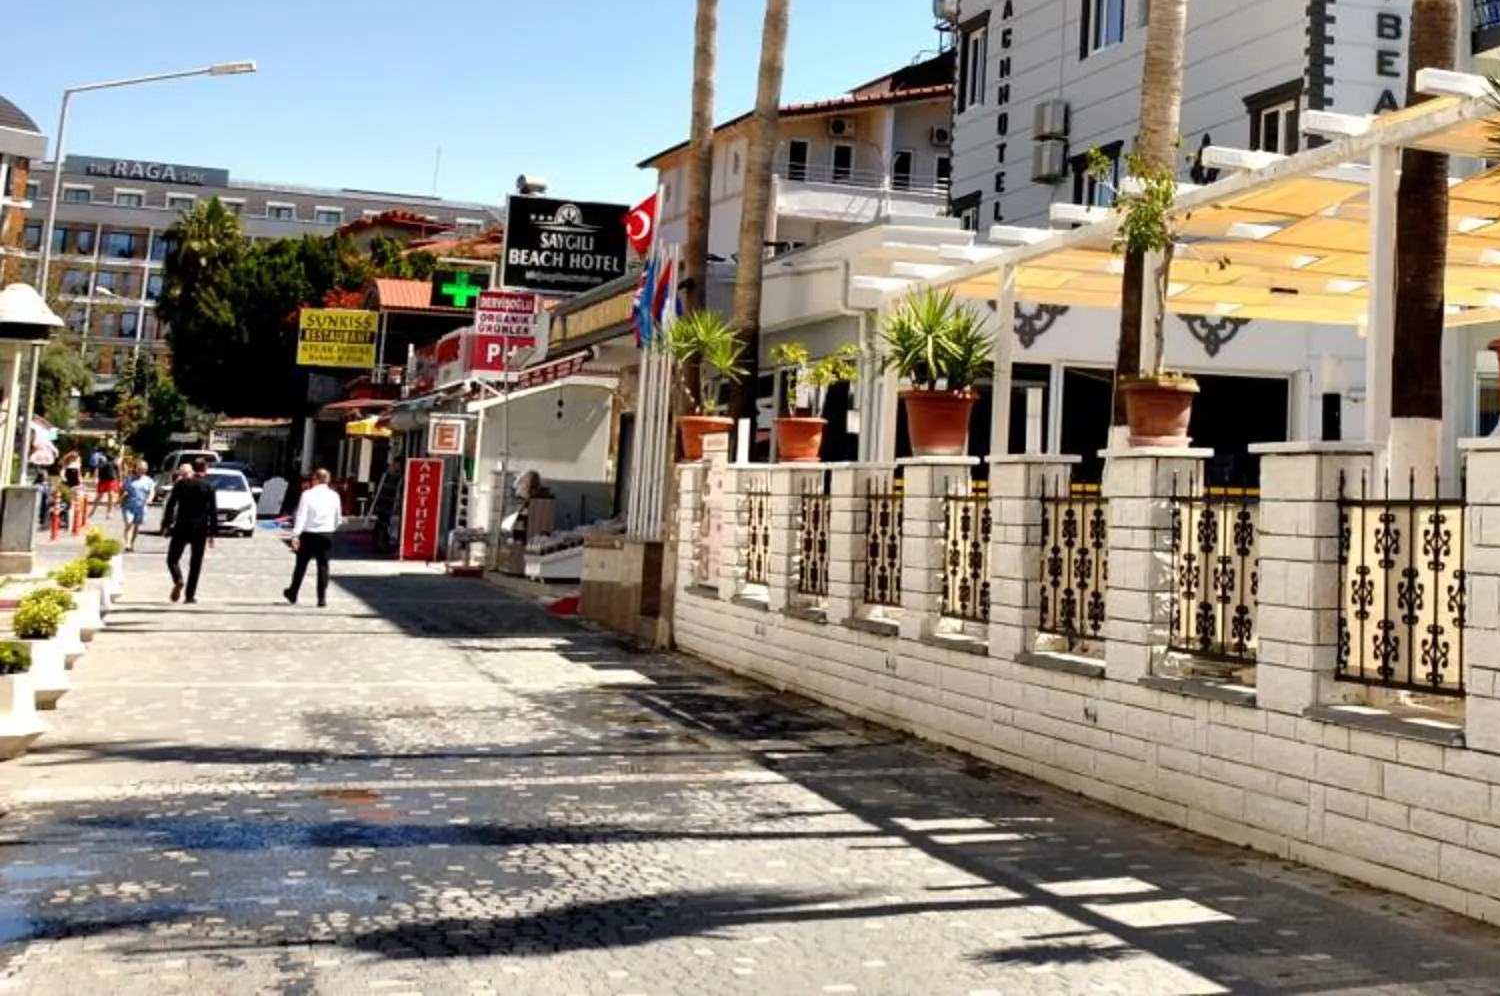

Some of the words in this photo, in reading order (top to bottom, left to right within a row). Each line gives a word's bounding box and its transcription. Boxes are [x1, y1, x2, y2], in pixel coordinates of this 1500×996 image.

[114, 160, 177, 181] RAGA
[540, 232, 594, 251] SAYGILI
[508, 248, 564, 268] BEACH
[569, 253, 621, 273] HOTEL
[306, 313, 373, 329] SUNKISS
[413, 461, 431, 553] APOTHEKE
